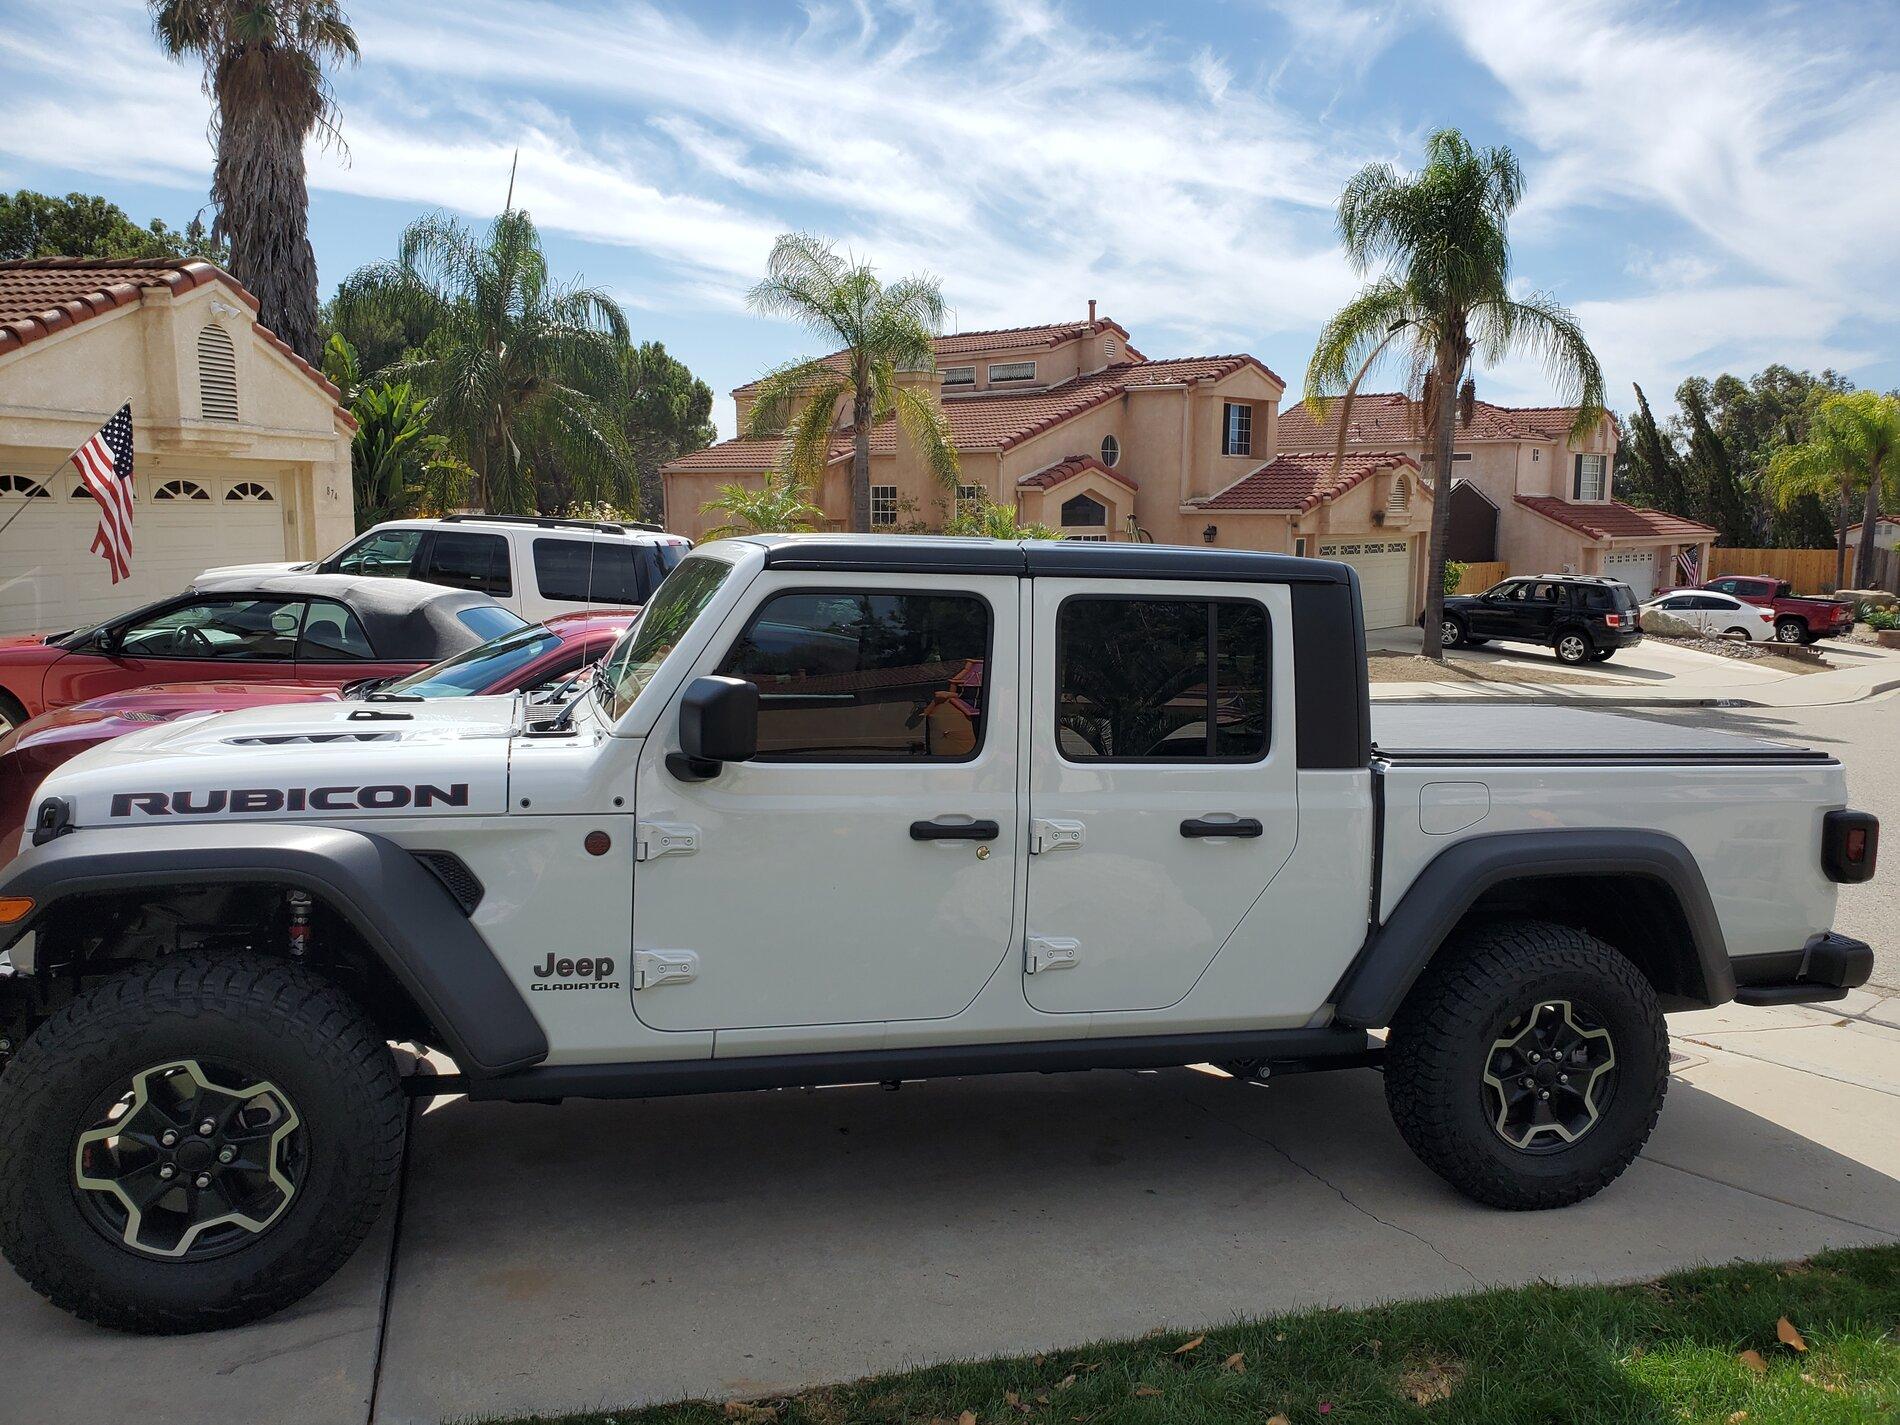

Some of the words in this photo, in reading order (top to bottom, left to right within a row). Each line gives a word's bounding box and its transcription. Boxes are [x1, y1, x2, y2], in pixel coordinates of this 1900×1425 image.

[110, 783, 469, 817] RUBICON
[533, 952, 615, 981] Jeep
[530, 982, 620, 991] GLADIATOR
